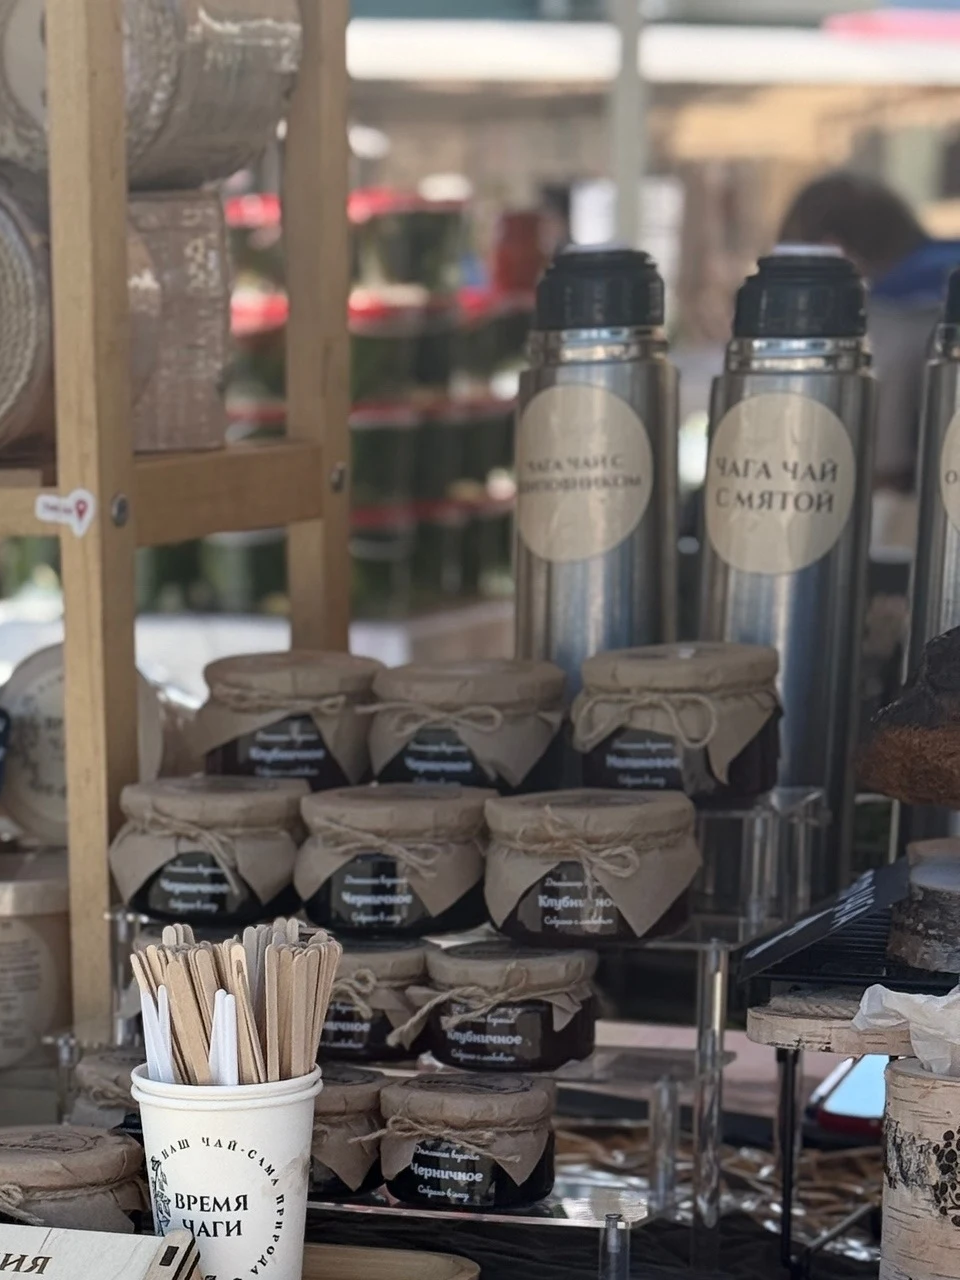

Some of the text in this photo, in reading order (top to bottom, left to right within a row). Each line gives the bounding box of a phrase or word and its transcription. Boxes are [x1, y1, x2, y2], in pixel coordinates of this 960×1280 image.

[715, 456, 839, 483] ЧАГА ЧАЙ
[715, 487, 836, 513] С МЯТОЙ
[410, 1162, 484, 1182] Черничное
[161, 1138, 190, 1160] НАШ
[249, 1193, 286, 1276] ПРИРОДА
[174, 1193, 249, 1213] ВРЕМЯ
[182, 1218, 243, 1238] ЧАГИ
